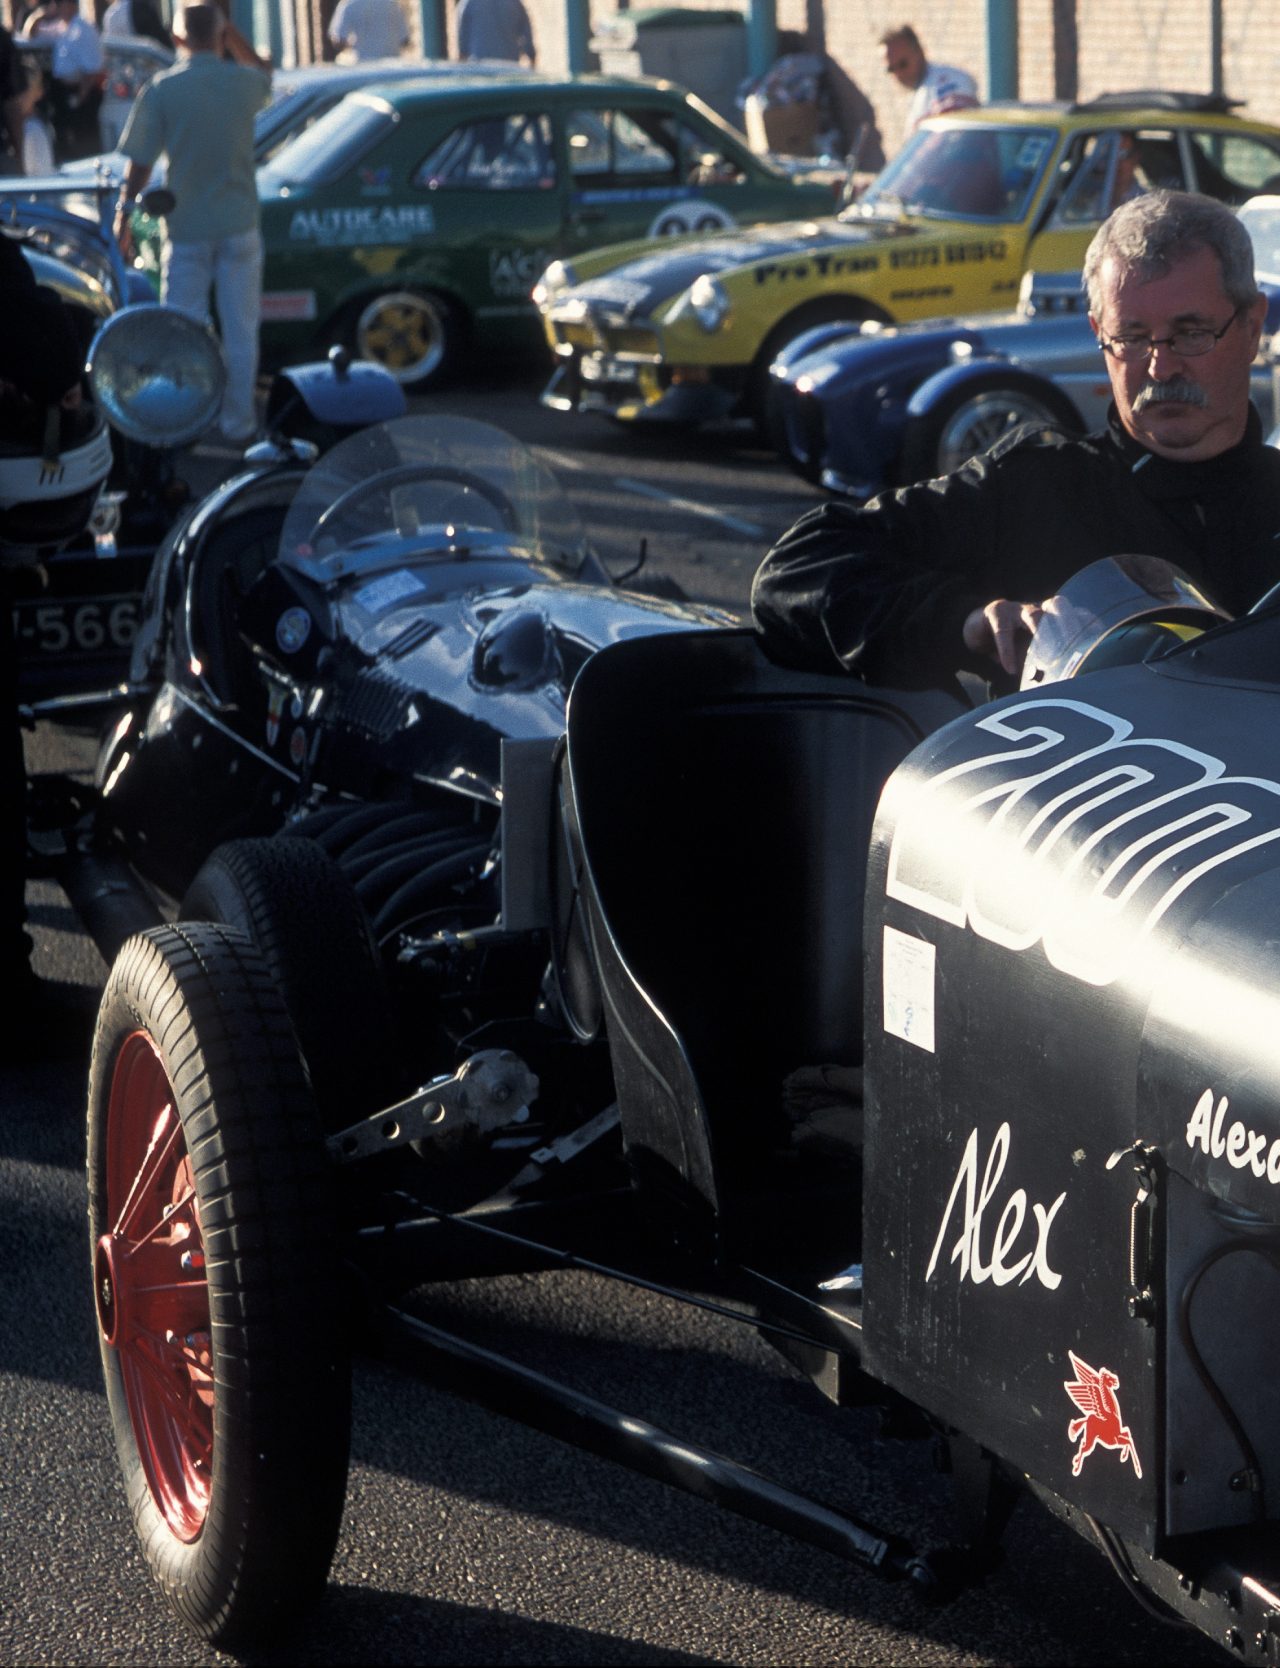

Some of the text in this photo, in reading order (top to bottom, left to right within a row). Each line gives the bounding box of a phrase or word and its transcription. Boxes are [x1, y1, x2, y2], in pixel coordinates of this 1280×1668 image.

[290, 204, 436, 239] AUTOCARE
[11, 602, 139, 651] -566
[925, 1121, 1067, 1290] Alex
